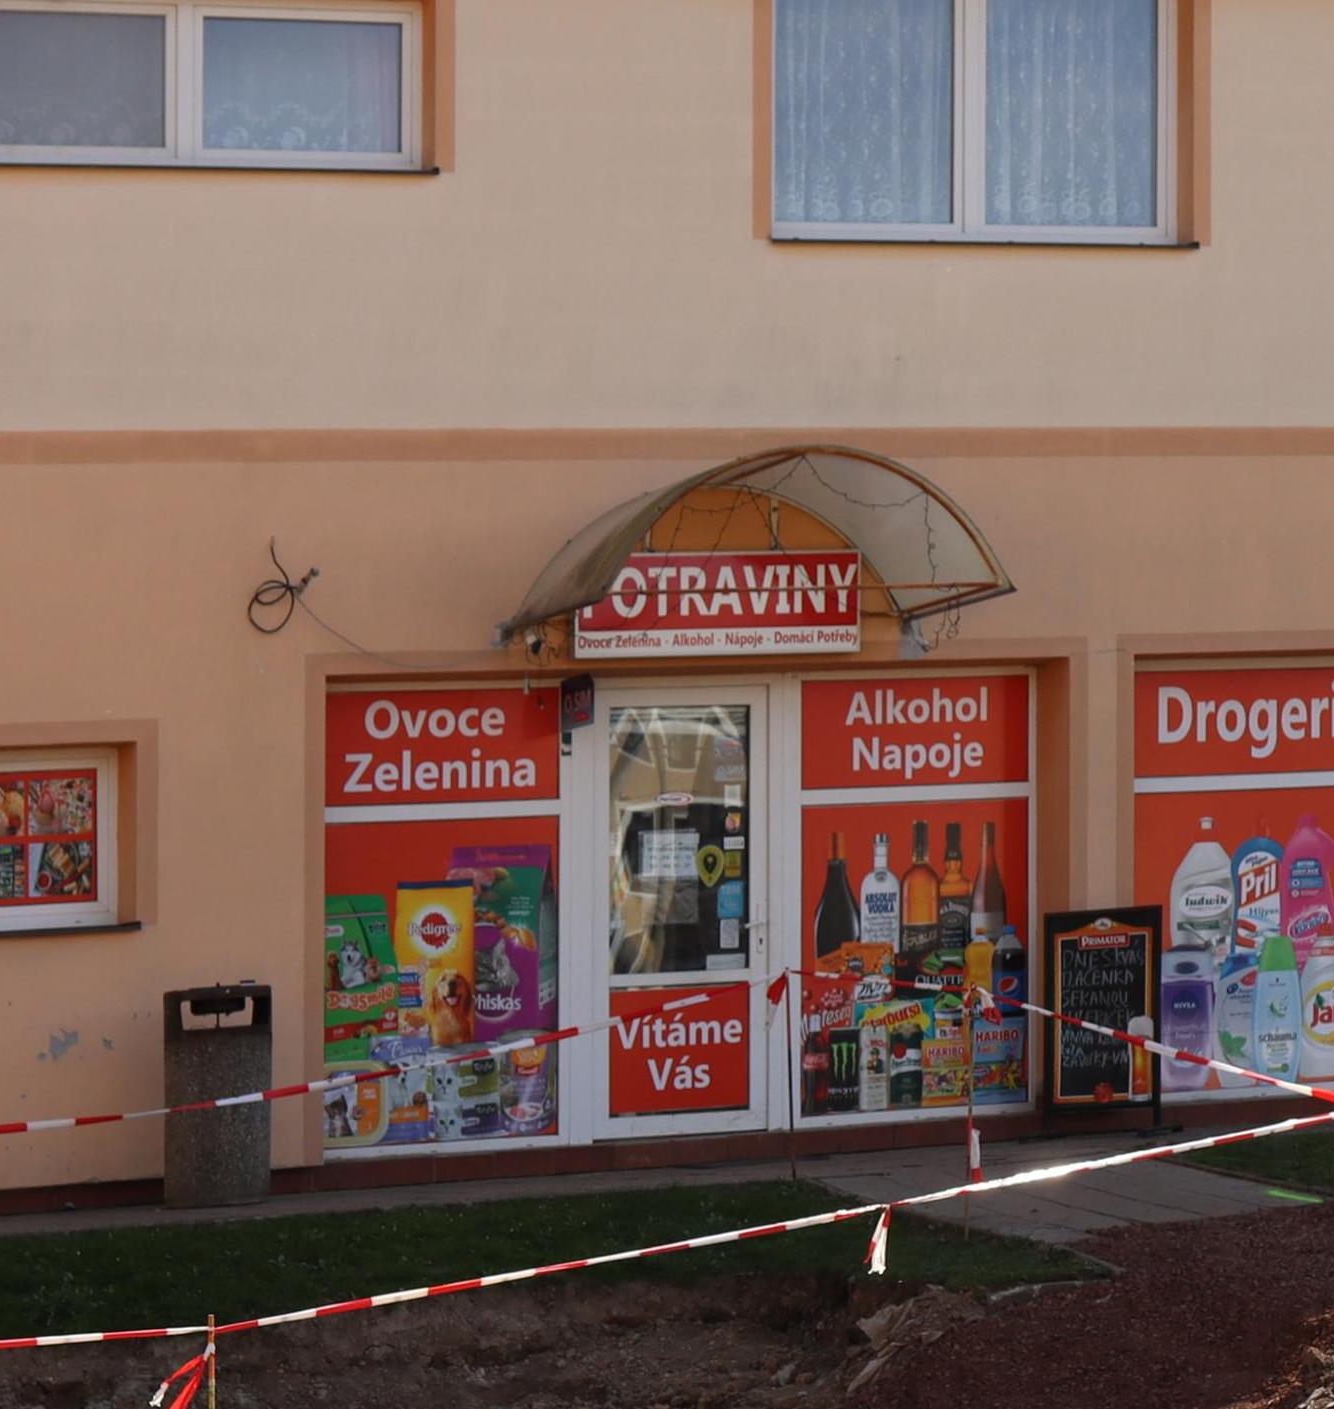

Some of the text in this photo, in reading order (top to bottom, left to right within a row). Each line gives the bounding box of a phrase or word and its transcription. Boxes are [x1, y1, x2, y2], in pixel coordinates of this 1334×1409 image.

[578, 635, 611, 649] Ovoce
[615, 633, 661, 648] Zelenina
[672, 633, 714, 646] Alkohol
[725, 631, 763, 648] Nápoje
[817, 628, 858, 646] Potřeby
[364, 700, 506, 740] Ovoce
[845, 686, 988, 726] Alkohol
[343, 748, 536, 793] Zelenina
[851, 732, 984, 779] Napoje
[1241, 862, 1277, 907] Pril
[616, 1013, 743, 1050] Vítáme
[975, 1029, 1019, 1042] HARIBO
[647, 1055, 711, 1091] Vás
